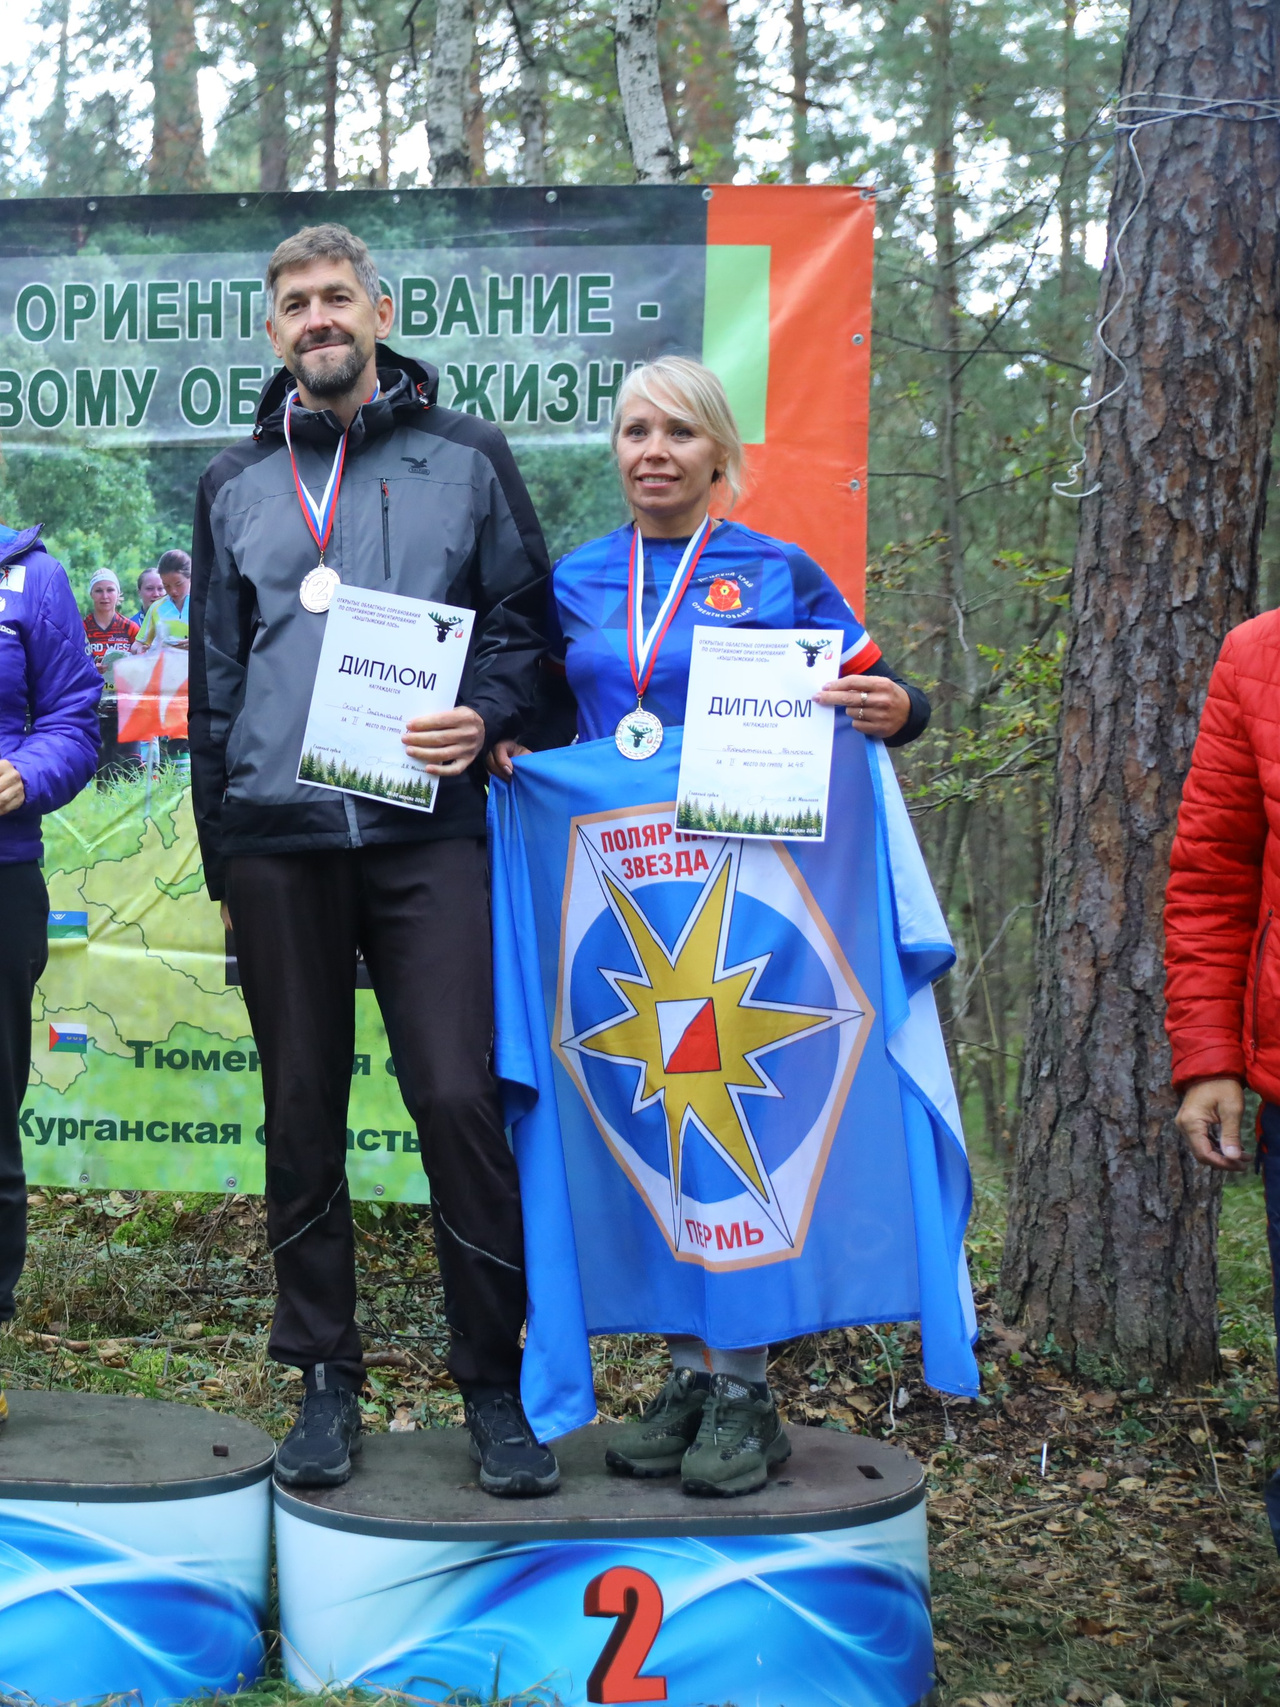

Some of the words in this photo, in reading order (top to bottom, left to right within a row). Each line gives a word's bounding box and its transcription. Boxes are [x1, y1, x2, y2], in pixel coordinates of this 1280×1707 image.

[15, 273, 613, 343] ОРИЕНТВАНИЕ
[446, 361, 640, 424] ЖИЗН
[337, 597, 360, 606] ОТКРЫТЫЕ
[361, 602, 386, 612] ОБЛАСТНЫЕ
[386, 607, 421, 618] СОРЕВНОВАНИЯ
[345, 606, 376, 616] СПОРТИВНОМУ
[376, 613, 416, 624] ОРИЕНТИРОВАНИЮ
[709, 647, 743, 655] СПОРТИВНОМУ
[338, 654, 437, 691] ДИПЛОМ
[369, 683, 401, 694] НАГРАЖДАЕТСЯ
[708, 696, 812, 718] ДИПЛОМ
[365, 722, 379, 730] МЕСТО
[600, 822, 718, 853] ПОЛЯР
[621, 848, 709, 880] ЗВЕЗДА
[685, 1219, 764, 1250] ПЕРМЬ
[583, 1565, 668, 1705] 2
